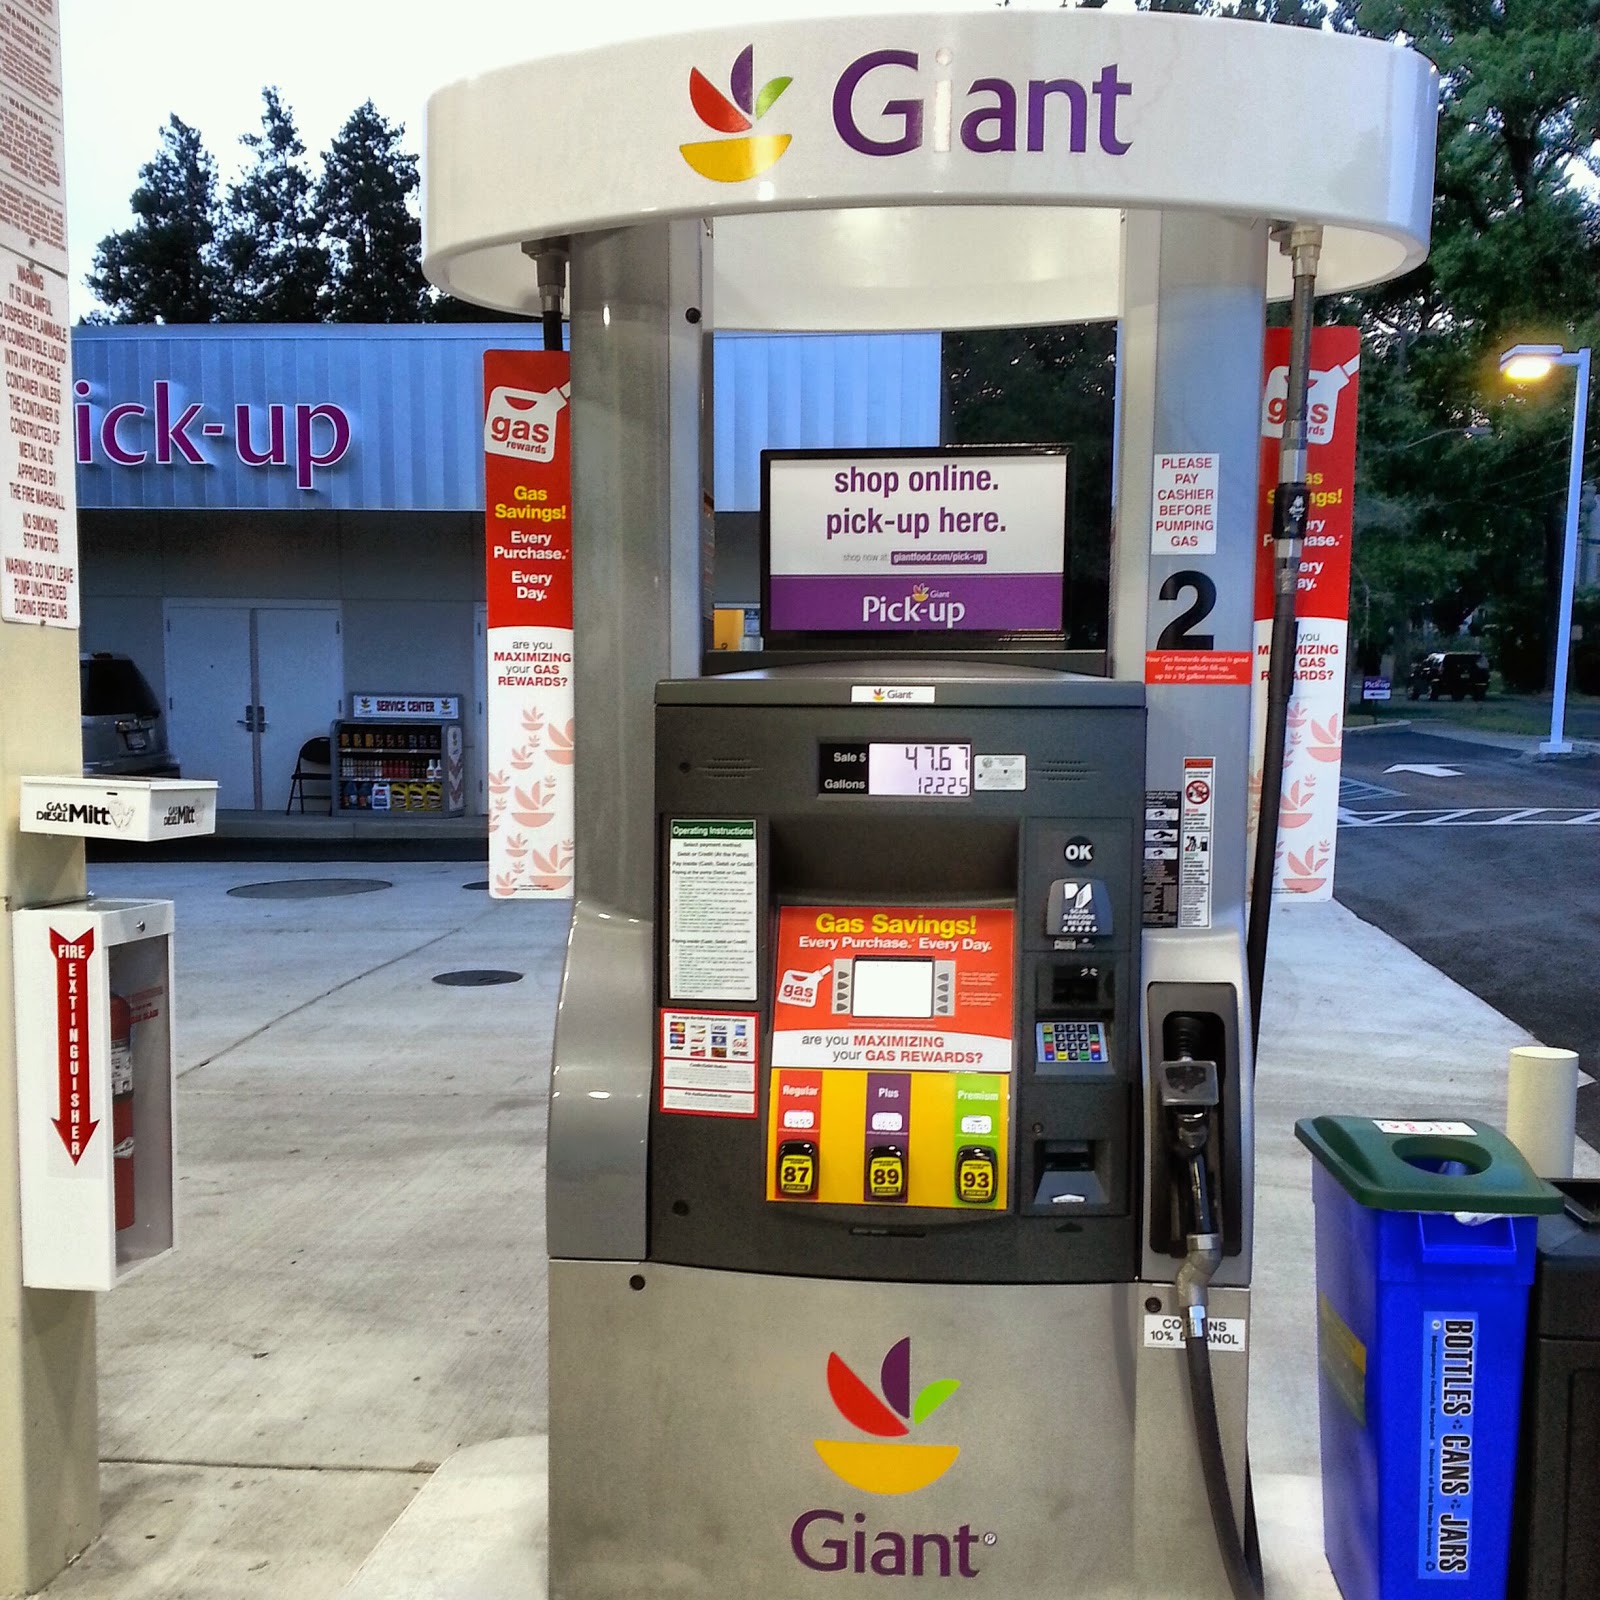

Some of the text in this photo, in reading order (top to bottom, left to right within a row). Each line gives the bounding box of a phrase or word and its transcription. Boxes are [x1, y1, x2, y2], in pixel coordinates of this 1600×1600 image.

[833, 48, 1134, 156] Giant
[17, 264, 44, 291] WARNING
[4, 303, 33, 330] DISPENSE
[7, 326, 47, 357] COMBUSTIBLE
[32, 358, 61, 383] PORTABLE
[6, 371, 38, 397] CONTAINER
[9, 393, 21, 413] THE
[21, 398, 53, 422] CONTAINER
[1267, 398, 1329, 425] gs
[10, 416, 60, 446] CONSTRUCTED OF
[75, 379, 351, 489] ick-up
[491, 416, 549, 443] gas
[19, 441, 38, 461] METAL
[506, 441, 547, 454] rewards
[1161, 458, 1213, 469] PLEASE
[17, 462, 57, 487] APPROVED BY
[834, 464, 999, 498] shop online.
[1175, 473, 1199, 484] PAY
[9, 482, 21, 501] THE
[22, 485, 35, 504] FIRE
[514, 485, 548, 501] Gas
[1157, 489, 1214, 501] CASHIER
[1267, 488, 1343, 507] Sngs!
[495, 503, 566, 522] Savings!
[1159, 504, 1212, 516] BEFORE
[826, 507, 1007, 540] pick-up here.
[1155, 520, 1214, 531] PUMPING
[23, 532, 38, 549] STOP
[511, 530, 552, 546] Every
[1170, 536, 1199, 547] GAS
[893, 552, 984, 563] giantfood.com/pick-up
[511, 570, 552, 586] Every
[517, 586, 547, 601] Day.
[930, 590, 951, 598] Giant
[863, 596, 965, 629] Pick-up
[1156, 570, 1217, 650] 2
[512, 641, 553, 651] are you
[1299, 633, 1320, 643] you
[494, 652, 571, 662] MAXIMIZING
[1258, 645, 1339, 655] MMIZING
[506, 665, 560, 675] your GAS
[1299, 657, 1326, 668] GAS
[498, 676, 568, 687] REWARDS?
[1261, 670, 1334, 681] RARDS?
[887, 689, 913, 699] Giant
[376, 700, 406, 712] SERVICE
[407, 701, 435, 712] CENTER
[833, 752, 866, 763] Sale $
[905, 746, 969, 771] 47.67
[824, 779, 866, 790] Gallons
[46, 801, 68, 812] GAS
[69, 803, 111, 826] Mitt
[36, 810, 68, 823] DIESEL
[177, 805, 195, 825] Mitt
[673, 825, 754, 836] Operating Instructions
[1065, 844, 1093, 861] OK
[815, 912, 977, 939] Gas Savings!
[58, 944, 85, 960] FIRE
[799, 936, 838, 950] Every
[919, 938, 959, 952] Every
[962, 938, 992, 952] Day.
[783, 984, 814, 997] gas
[801, 1035, 945, 1048] are you MAXIMIZING
[67, 962, 81, 1156] EXTINGUISHER
[832, 1050, 984, 1064] your GAS REWARDS?
[782, 1084, 999, 1101] Regular Plus Premium
[783, 1165, 990, 1188] 87 89 93
[1162, 1319, 1227, 1332] CONS
[1150, 1330, 1239, 1345] 10% EANOL
[1437, 1319, 1475, 1573] BOTTLES CANS JARS
[790, 1508, 980, 1578] Giant
